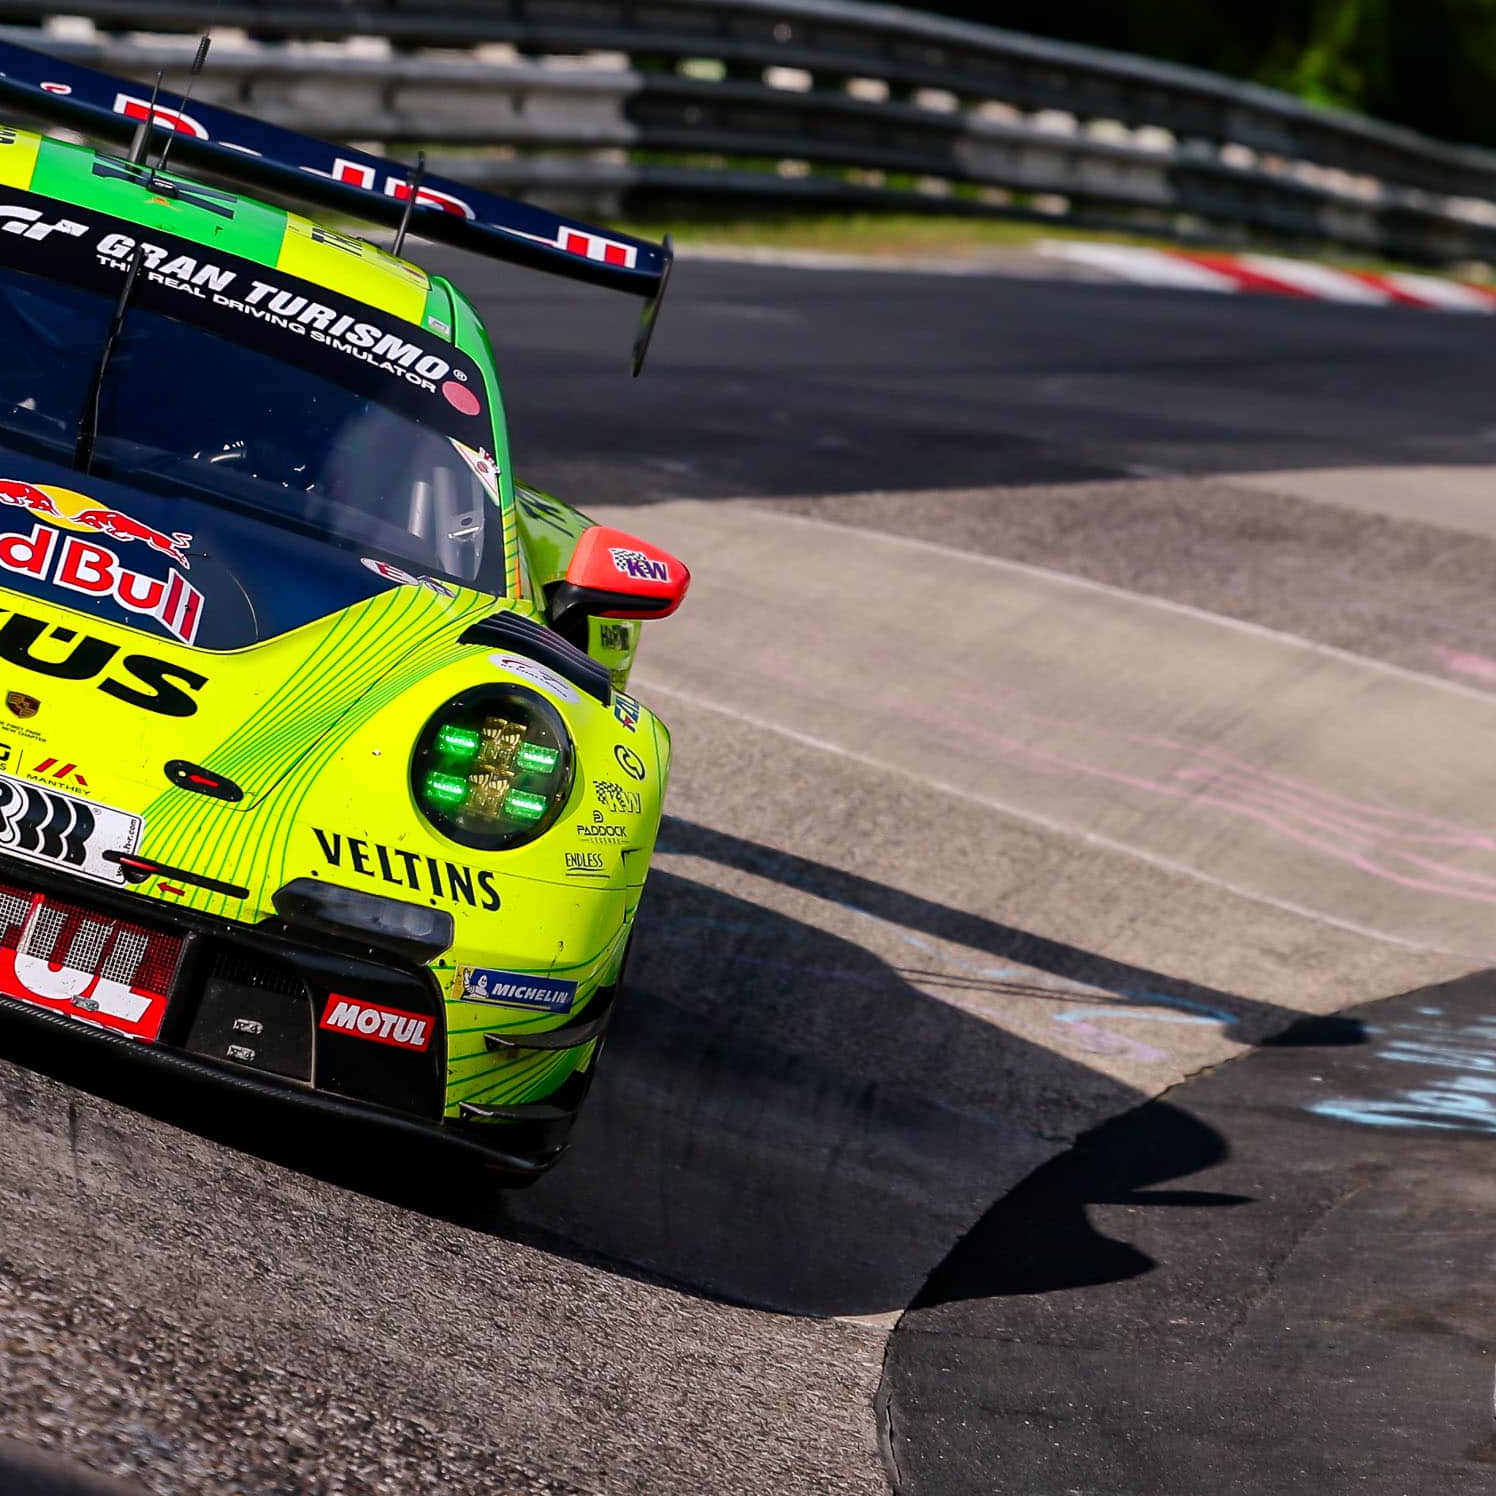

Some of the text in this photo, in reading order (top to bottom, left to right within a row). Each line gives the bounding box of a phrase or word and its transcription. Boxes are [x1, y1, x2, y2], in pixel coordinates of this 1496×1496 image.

[96, 233, 237, 292] GRAN
[244, 281, 450, 380] TURISMO
[148, 272, 206, 299] REAL
[213, 294, 305, 335] DRIVING
[310, 330, 436, 393] SIMULATOR
[625, 558, 667, 581] KW
[57, 538, 202, 644] Bull
[26, 773, 91, 796] MANTHEY
[577, 825, 626, 837] PADDOCK
[311, 828, 502, 912] VELTINS
[565, 853, 603, 867] ENDLESS
[492, 983, 568, 1003] MICHELIN
[328, 1000, 428, 1047] MOTUL
